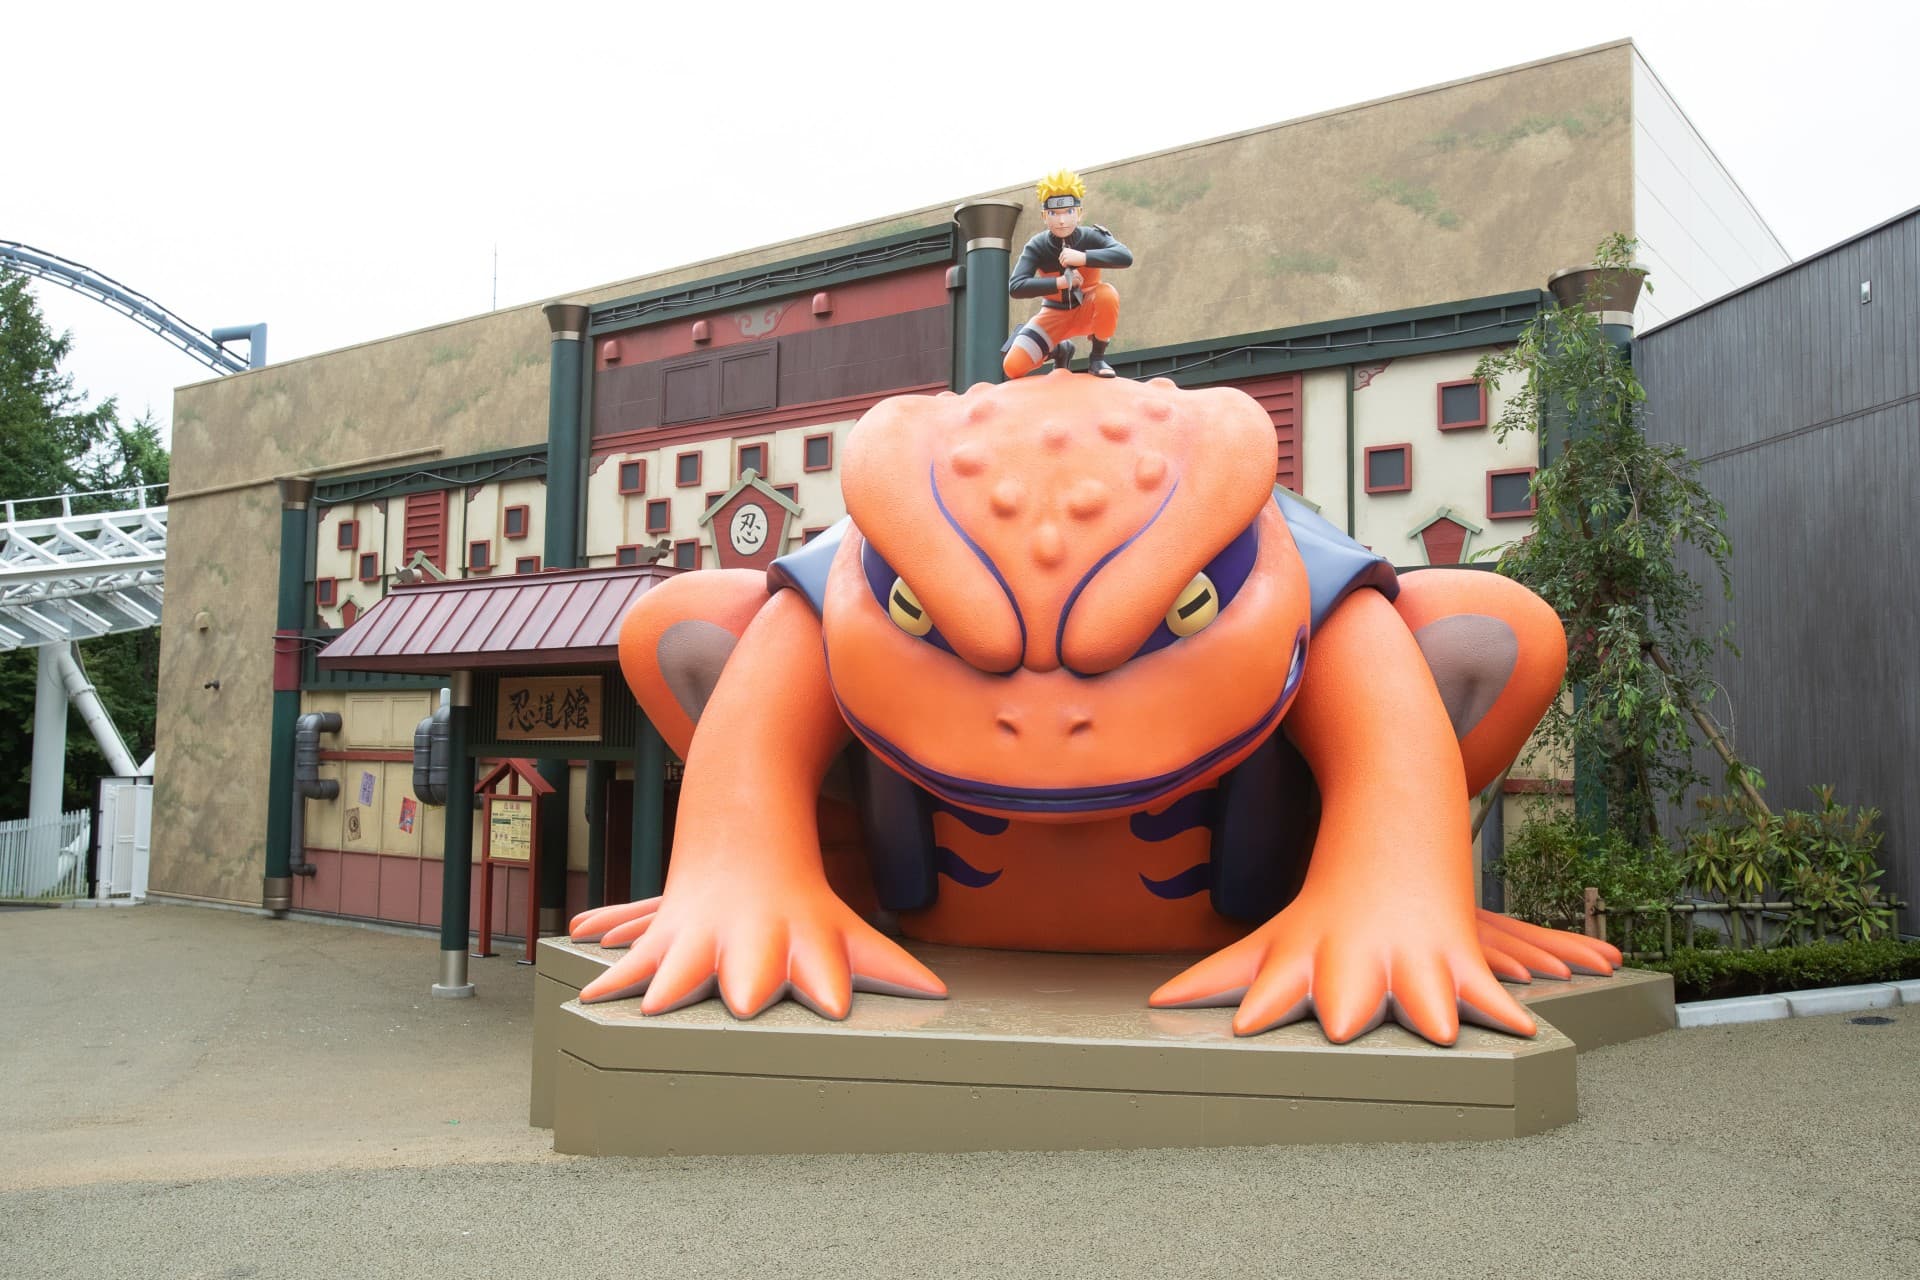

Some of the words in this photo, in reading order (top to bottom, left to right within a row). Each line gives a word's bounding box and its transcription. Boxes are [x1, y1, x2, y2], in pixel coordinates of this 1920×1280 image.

[736, 512, 761, 545] 忍
[508, 686, 591, 732] 忍道館
